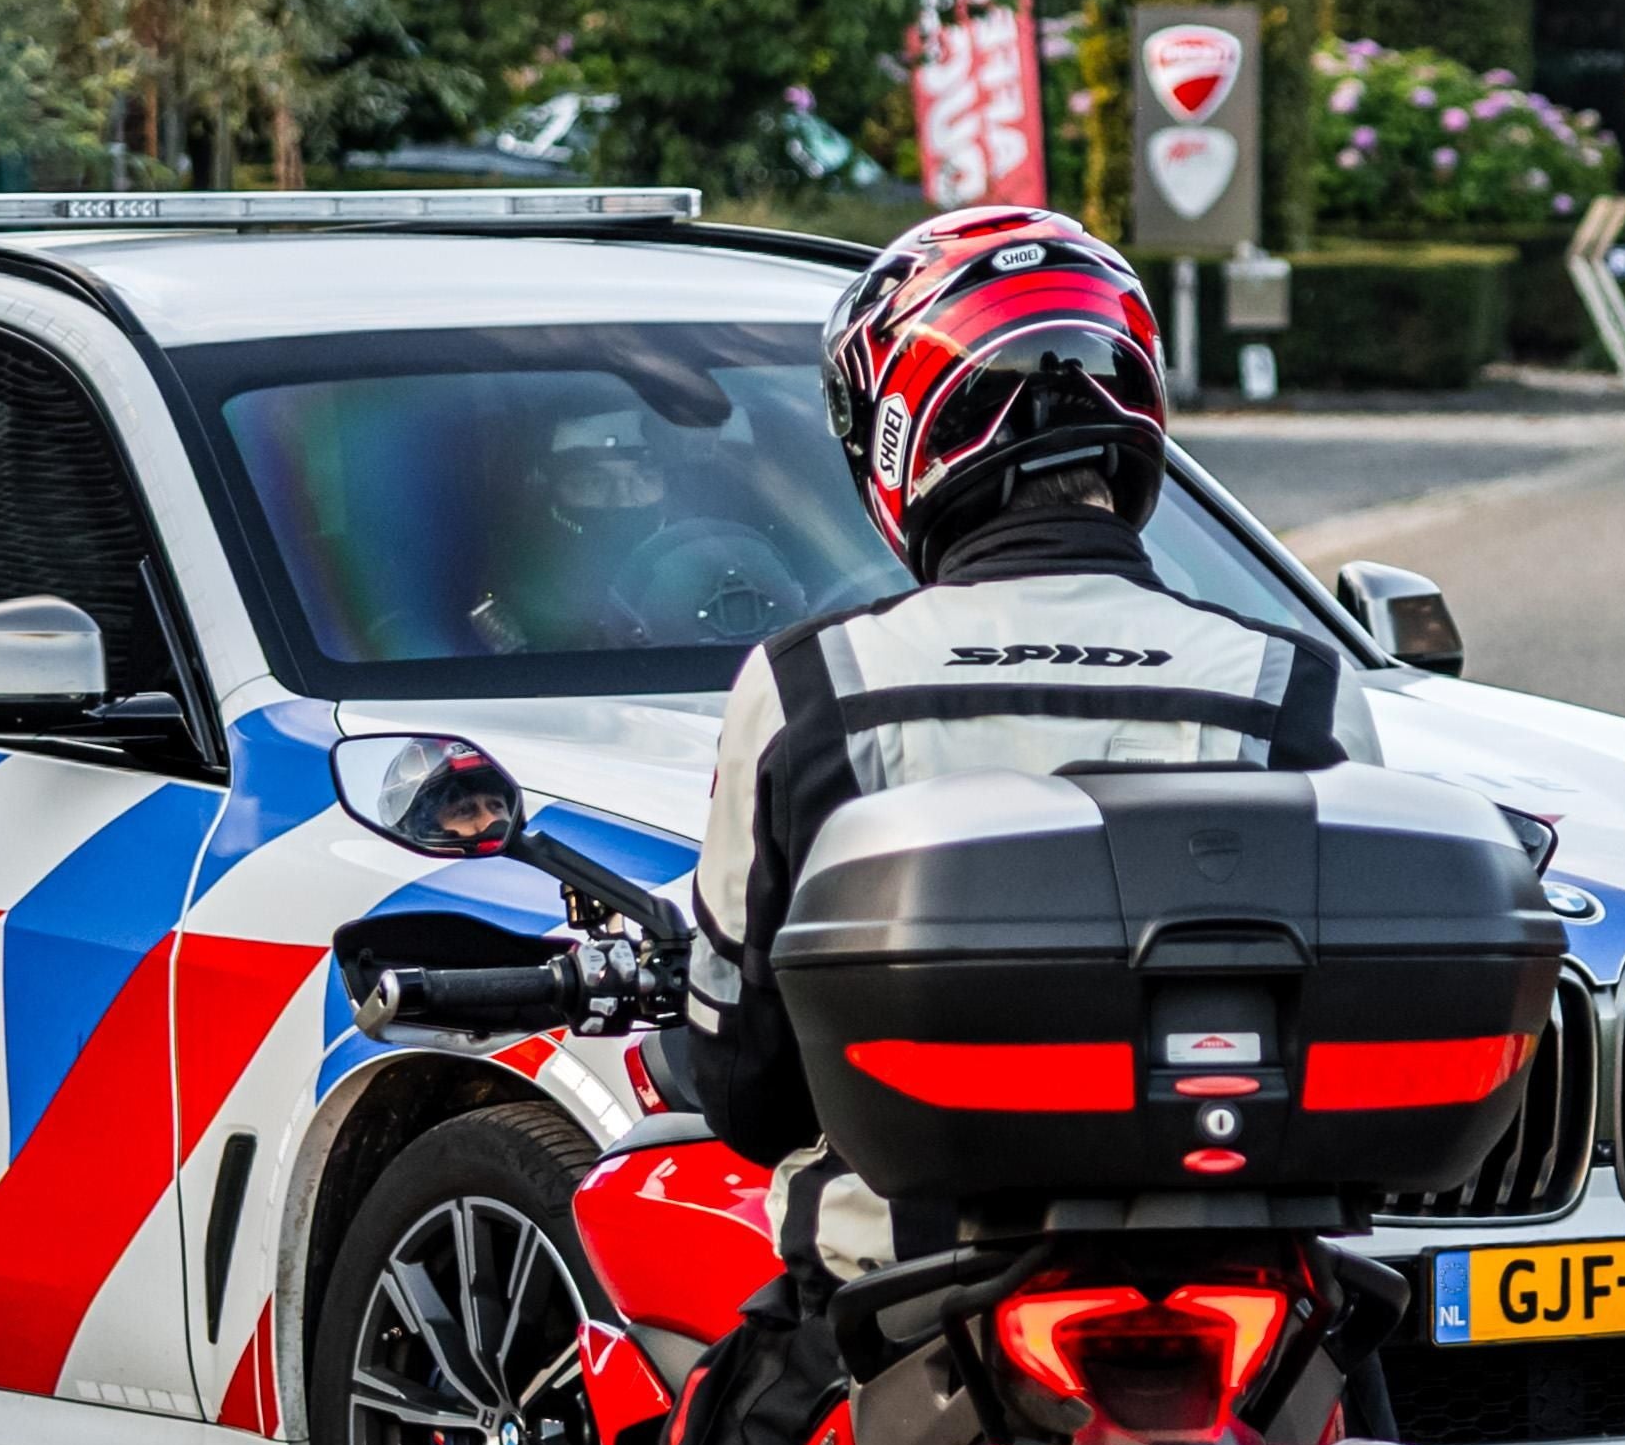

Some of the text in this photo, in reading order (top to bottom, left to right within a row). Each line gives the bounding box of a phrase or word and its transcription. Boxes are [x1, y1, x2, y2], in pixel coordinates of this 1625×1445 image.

[1001, 248, 1039, 266] SHOEI
[879, 406, 904, 479] SHOEI
[943, 643, 1174, 668] SPIDI
[1438, 1305, 1466, 1328] NL
